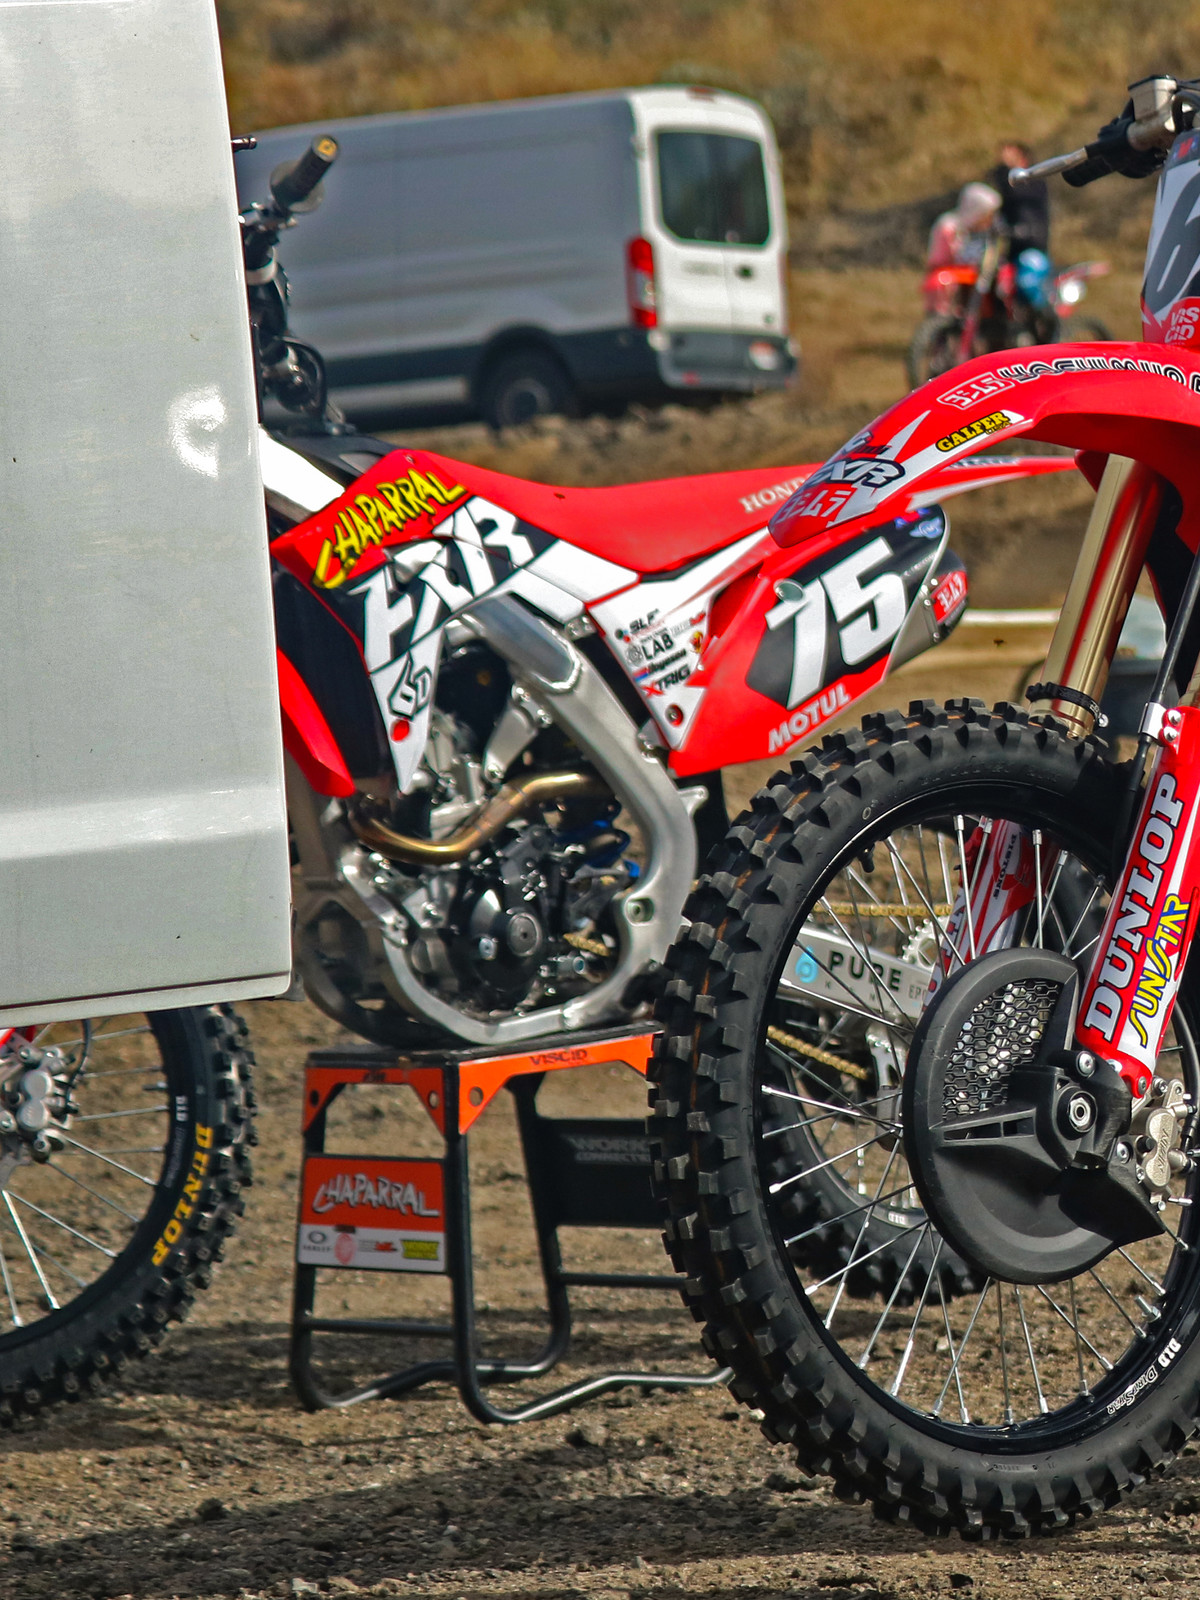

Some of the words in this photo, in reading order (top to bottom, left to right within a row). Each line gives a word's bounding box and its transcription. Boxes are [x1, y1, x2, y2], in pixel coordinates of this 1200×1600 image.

[936, 411, 1010, 452] GALFER
[313, 468, 468, 589] CHAPARRAL
[641, 632, 674, 660] LAB
[764, 536, 907, 712] 75
[641, 664, 691, 698] XTRIG
[767, 683, 852, 754] MOTUL
[1084, 772, 1185, 1043] DUNLOP
[529, 1048, 588, 1065] VISCID
[151, 1121, 214, 1268] DUNLOP
[312, 1172, 441, 1218] CHAPARRAL
[1157, 1337, 1182, 1368] DID
